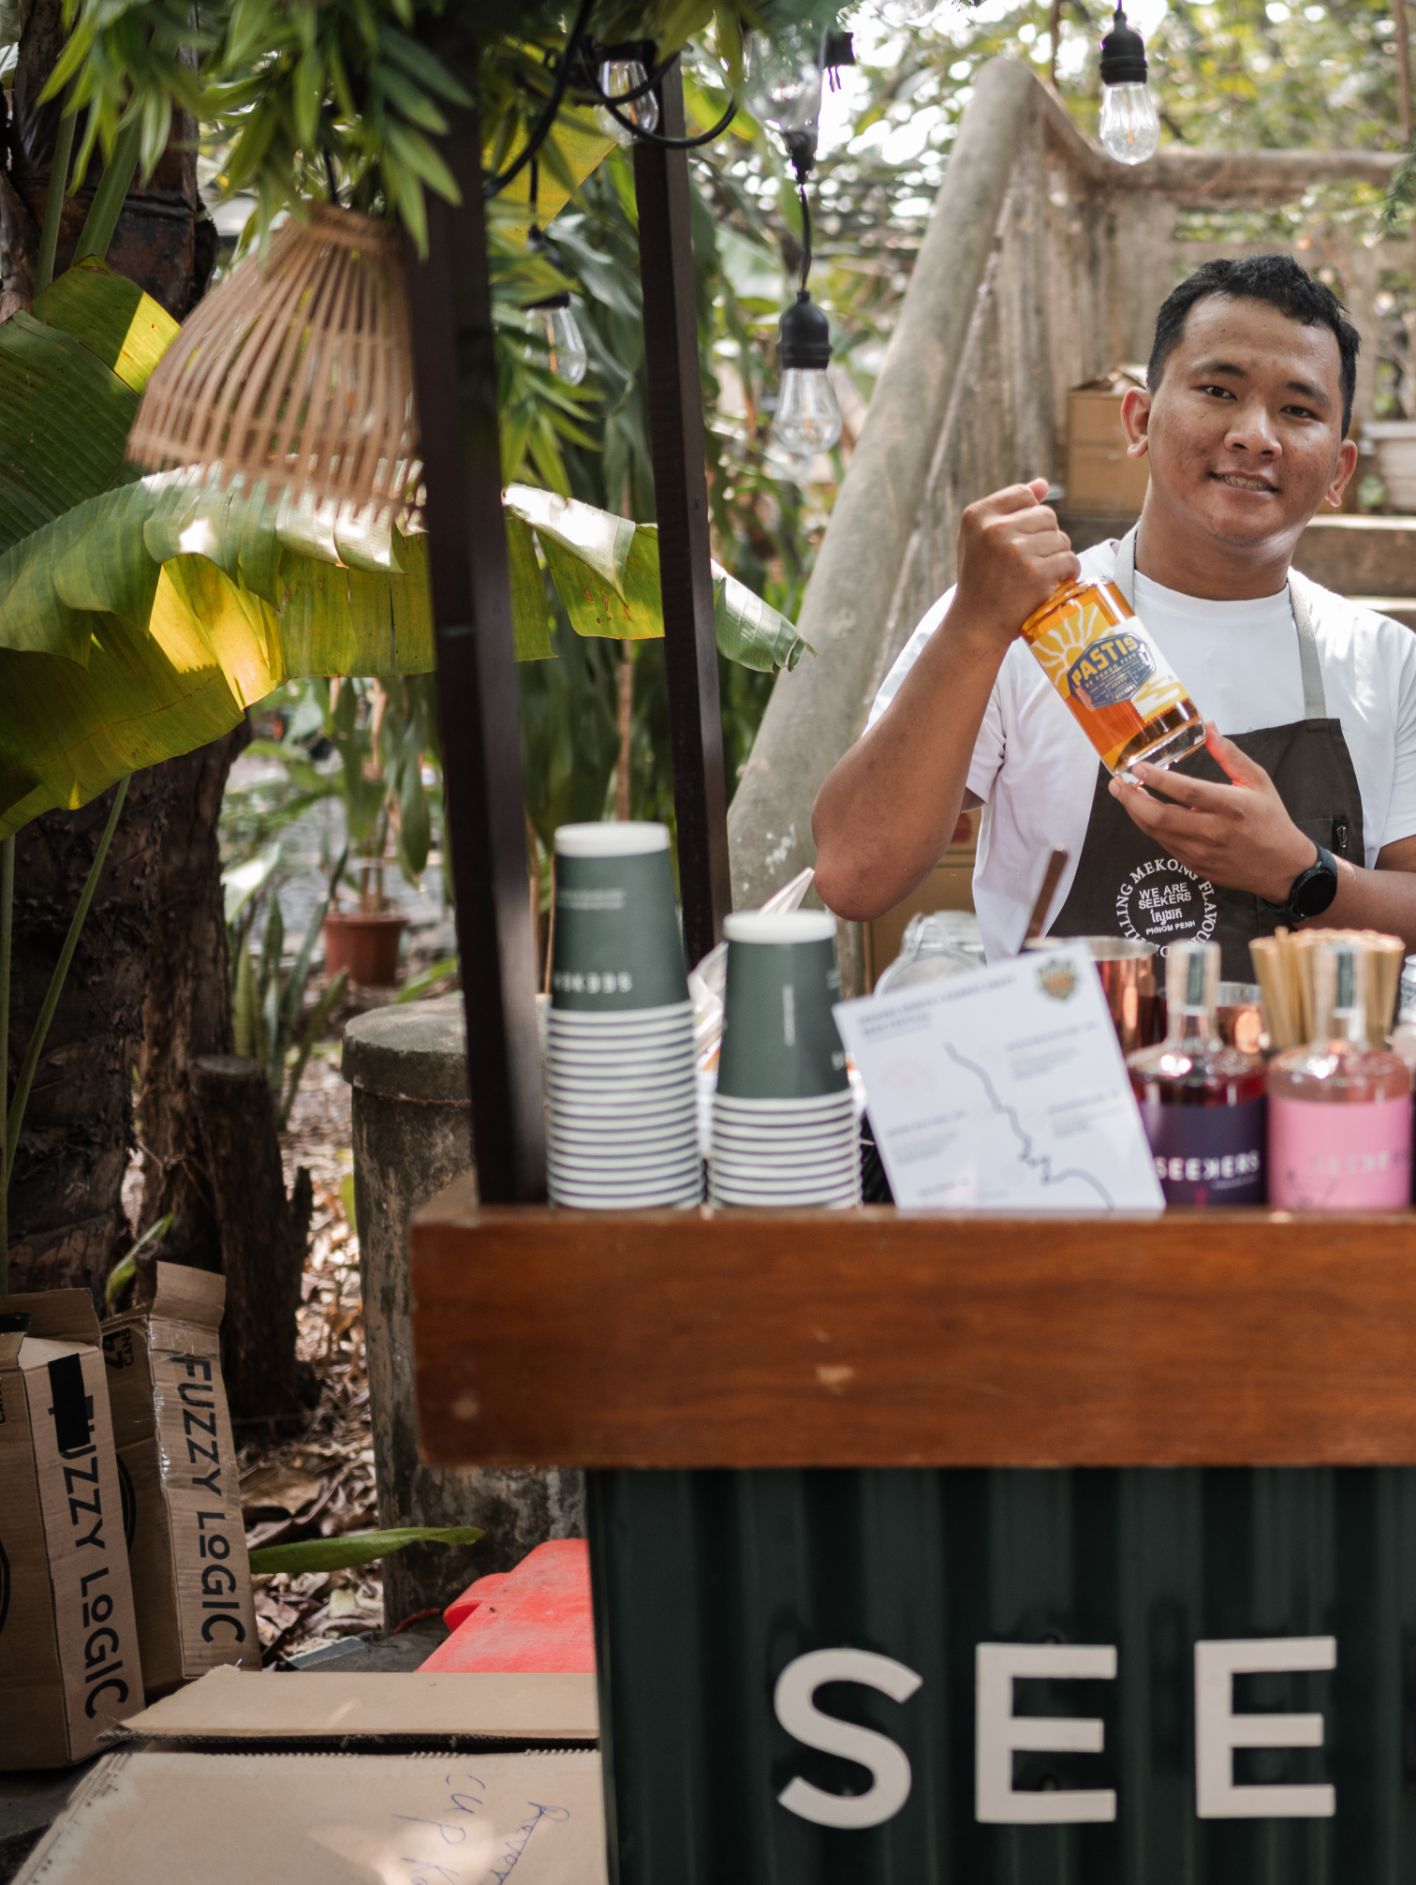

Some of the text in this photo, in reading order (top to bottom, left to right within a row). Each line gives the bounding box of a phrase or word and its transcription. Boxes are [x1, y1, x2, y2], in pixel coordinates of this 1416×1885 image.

[1071, 635, 1138, 688] PASTIS
[1138, 891, 1192, 910] SEEKERS
[1139, 882, 1188, 900] WE ARE
[1146, 920, 1196, 936] PHNOM PENH
[1153, 1149, 1260, 1182] SEEKERS
[169, 1352, 246, 1643] FUZZY LOGIC
[48, 1394, 129, 1720] UZZY LOGIC
